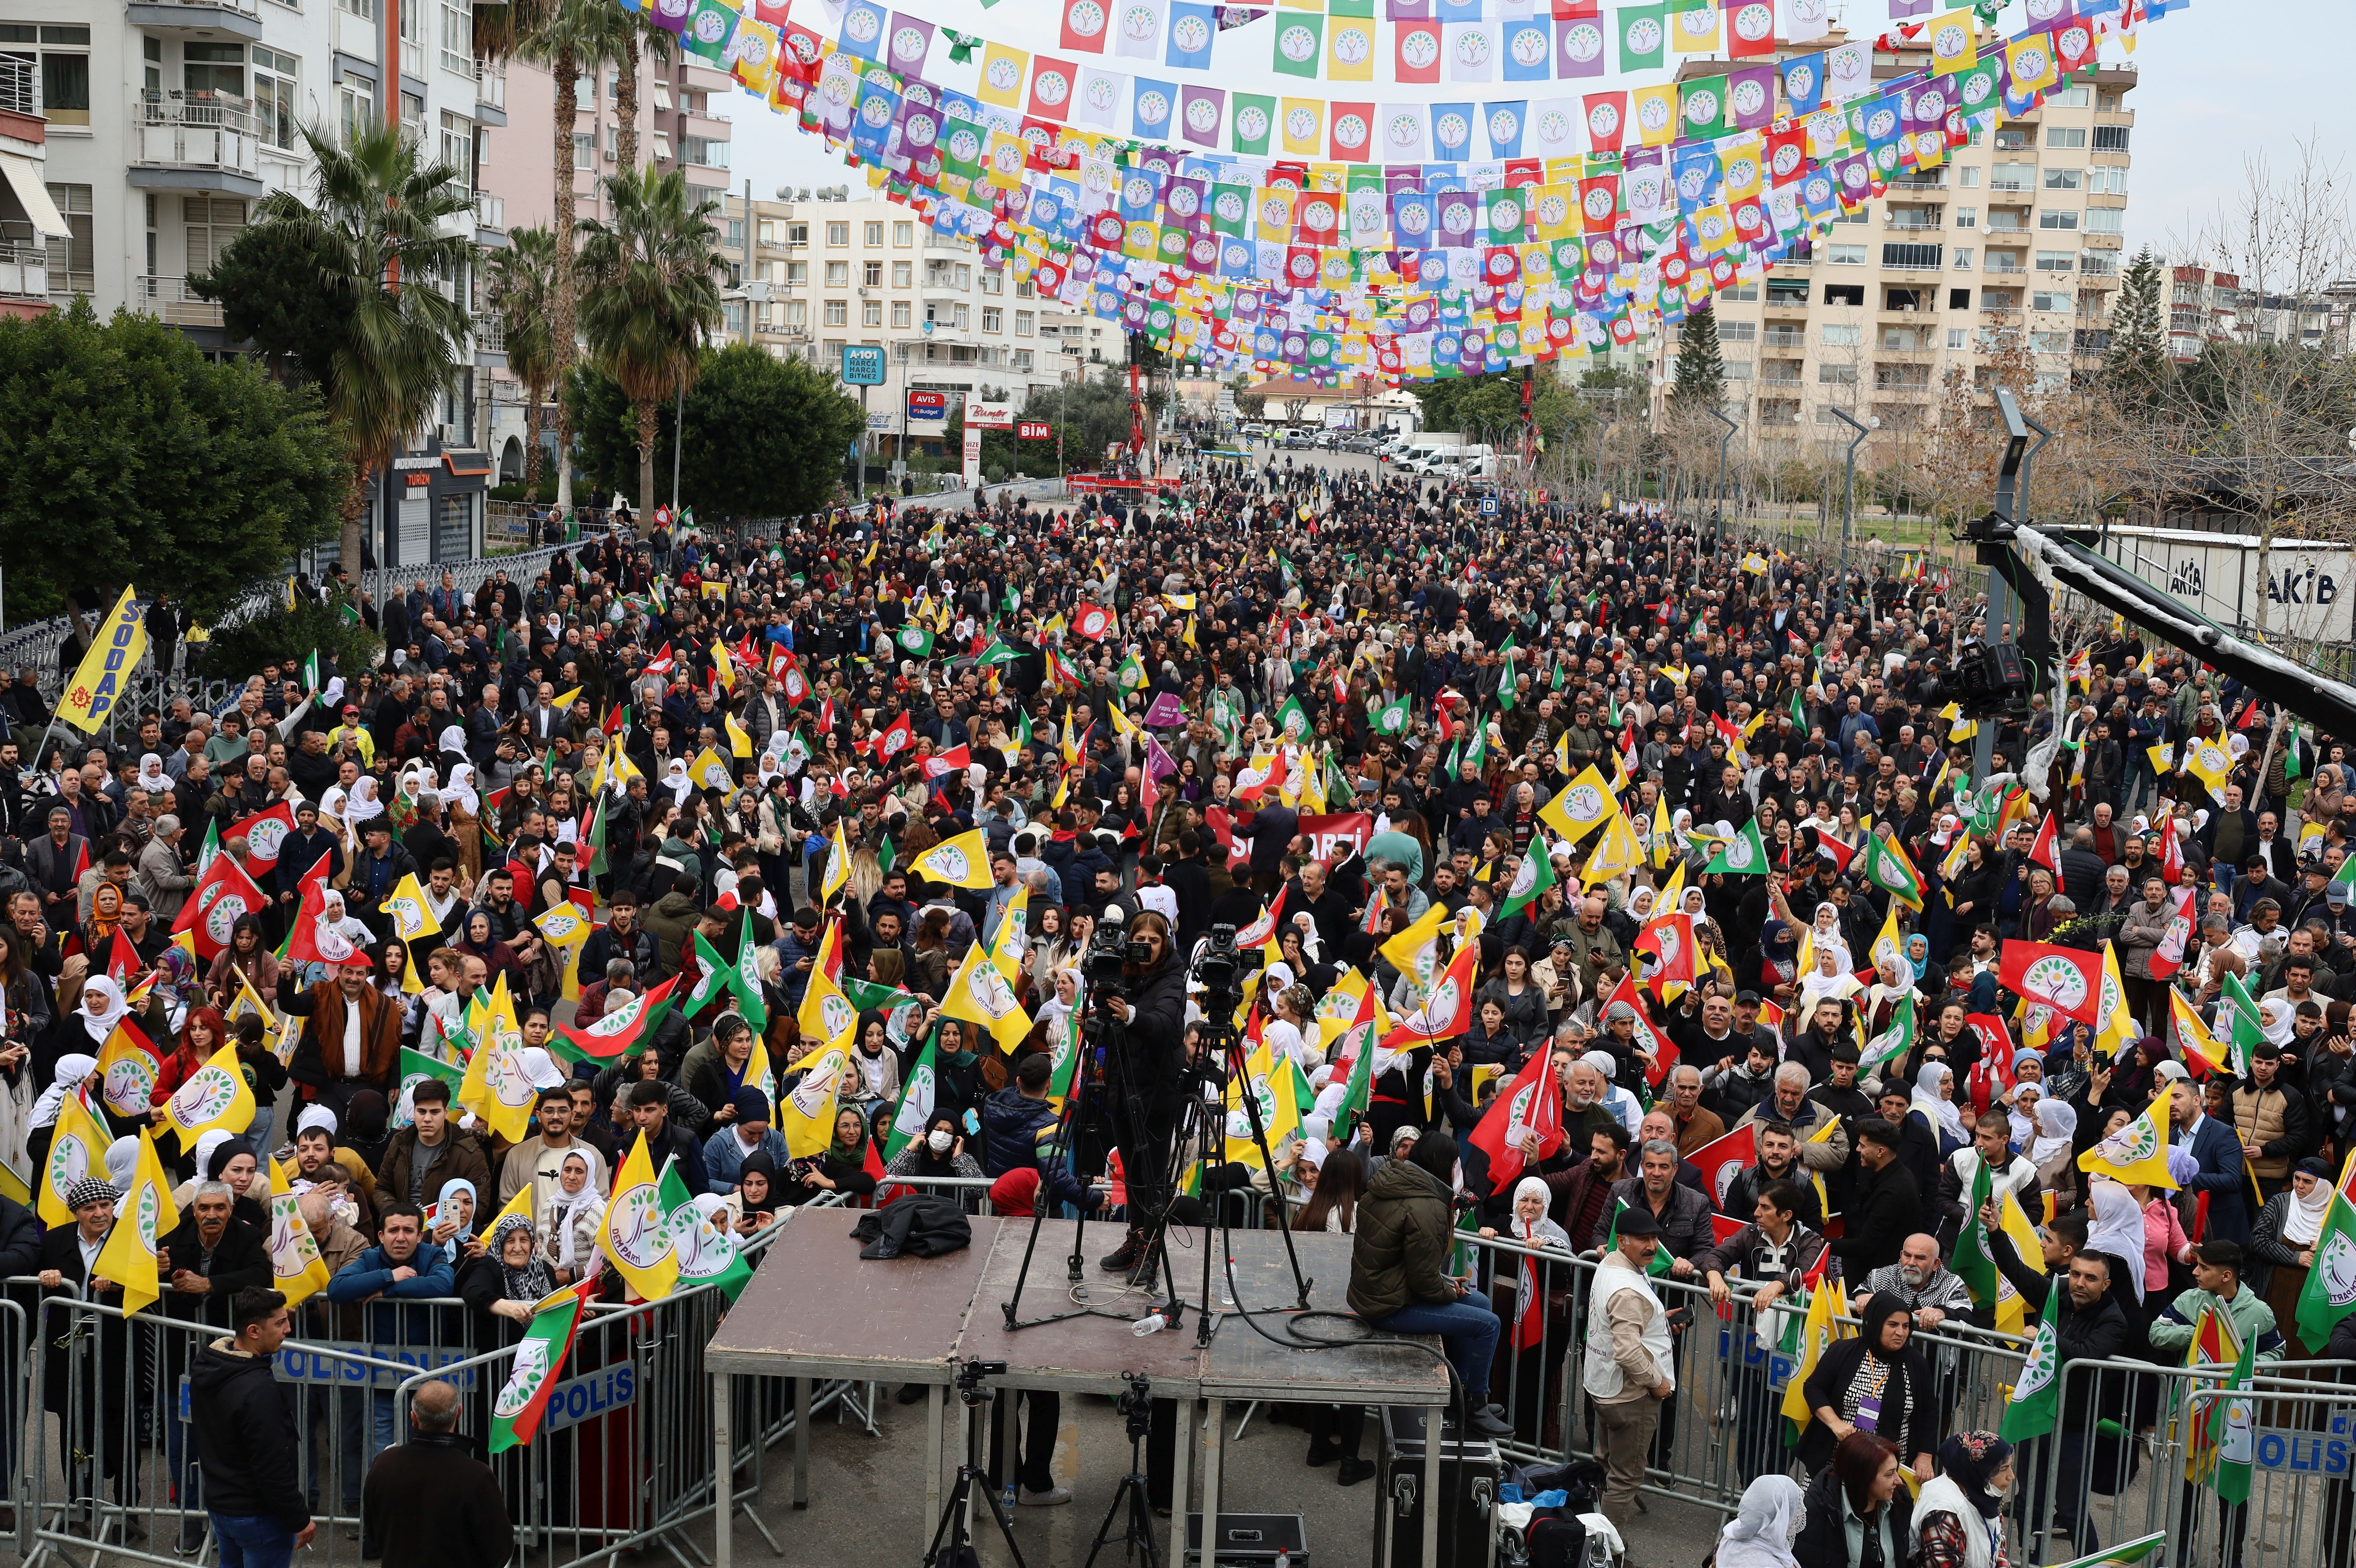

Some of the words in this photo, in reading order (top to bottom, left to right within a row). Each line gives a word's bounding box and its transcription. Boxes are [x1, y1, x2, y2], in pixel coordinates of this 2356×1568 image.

[970, 405, 1008, 417] Bumer
[1021, 423, 1047, 437] BİM
[407, 470, 430, 485] TURİZM
[1486, 501, 1493, 510] D
[88, 600, 139, 718] SODAP
[322, 946, 333, 957] DEM
[333, 949, 349, 958] PARTİ
[978, 996, 988, 1008] DEM
[105, 1088, 114, 1099] DEM
[177, 1111, 194, 1126] PART
[612, 1228, 622, 1248] DEM
[621, 1248, 640, 1265] PARTİ
[273, 1263, 285, 1274] RTİ
[1831, 1264, 1840, 1278] PAR
[1860, 1409, 1876, 1418] GÖREVLİ
